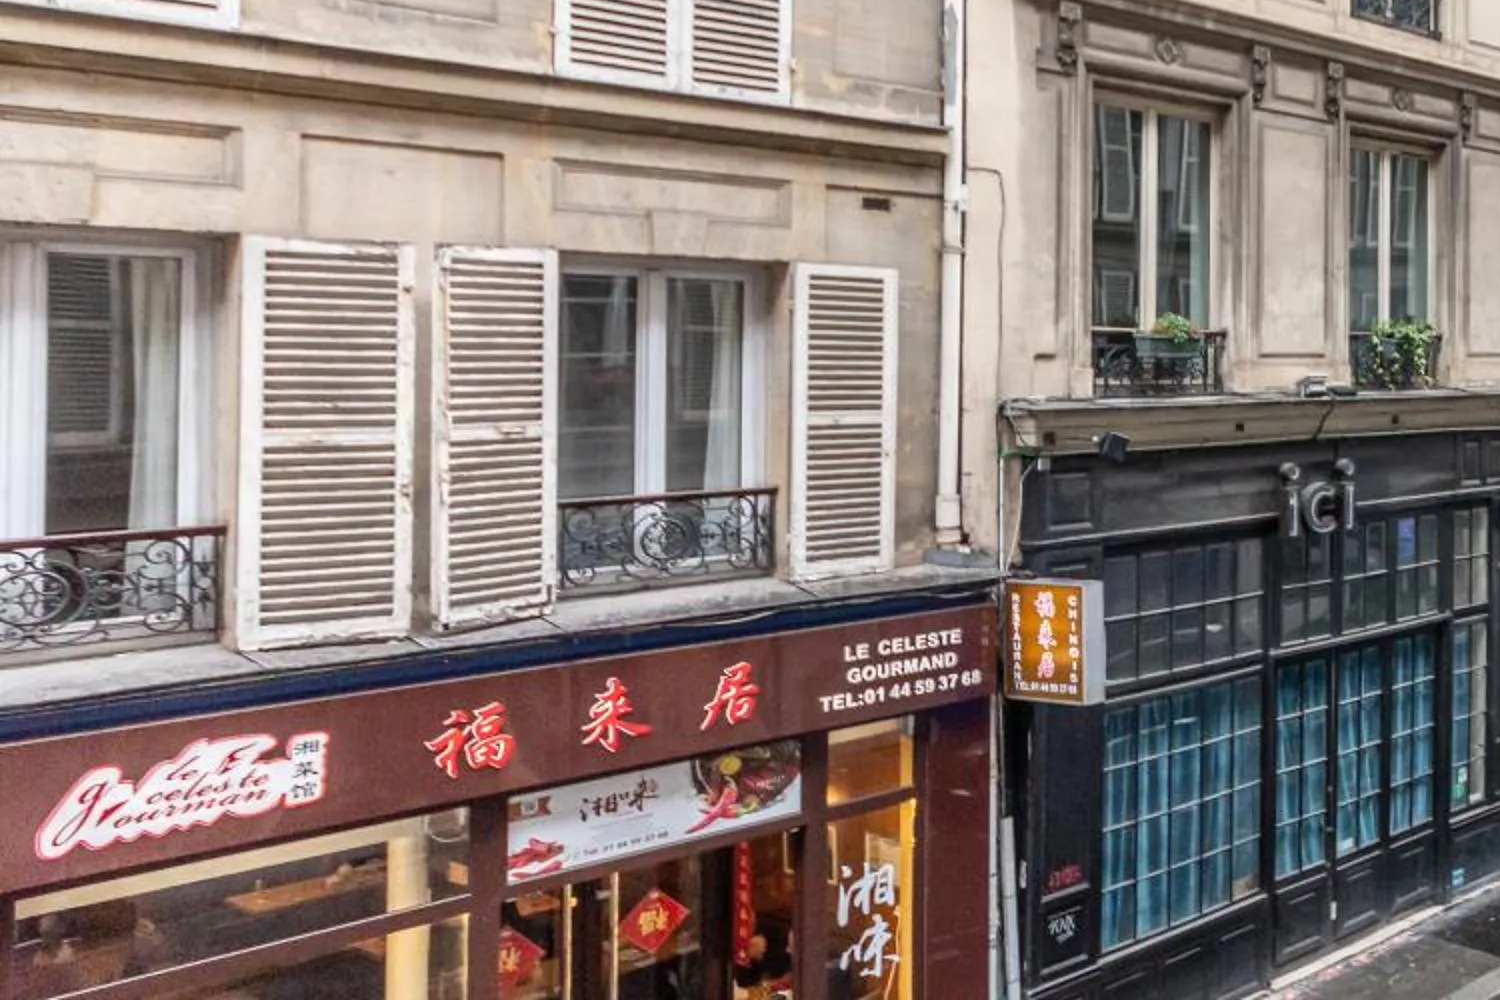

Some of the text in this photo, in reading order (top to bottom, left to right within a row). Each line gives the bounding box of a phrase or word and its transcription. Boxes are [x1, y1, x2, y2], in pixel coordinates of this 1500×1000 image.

[1279, 458, 1356, 537] ici
[844, 628, 963, 662] LE CELESTE
[1067, 595, 1079, 683] CHINOIS
[846, 652, 959, 684] GOURMAND
[889, 682, 912, 700] 44
[914, 678, 936, 695] 59
[938, 674, 959, 690] 37
[961, 669, 982, 686] 68
